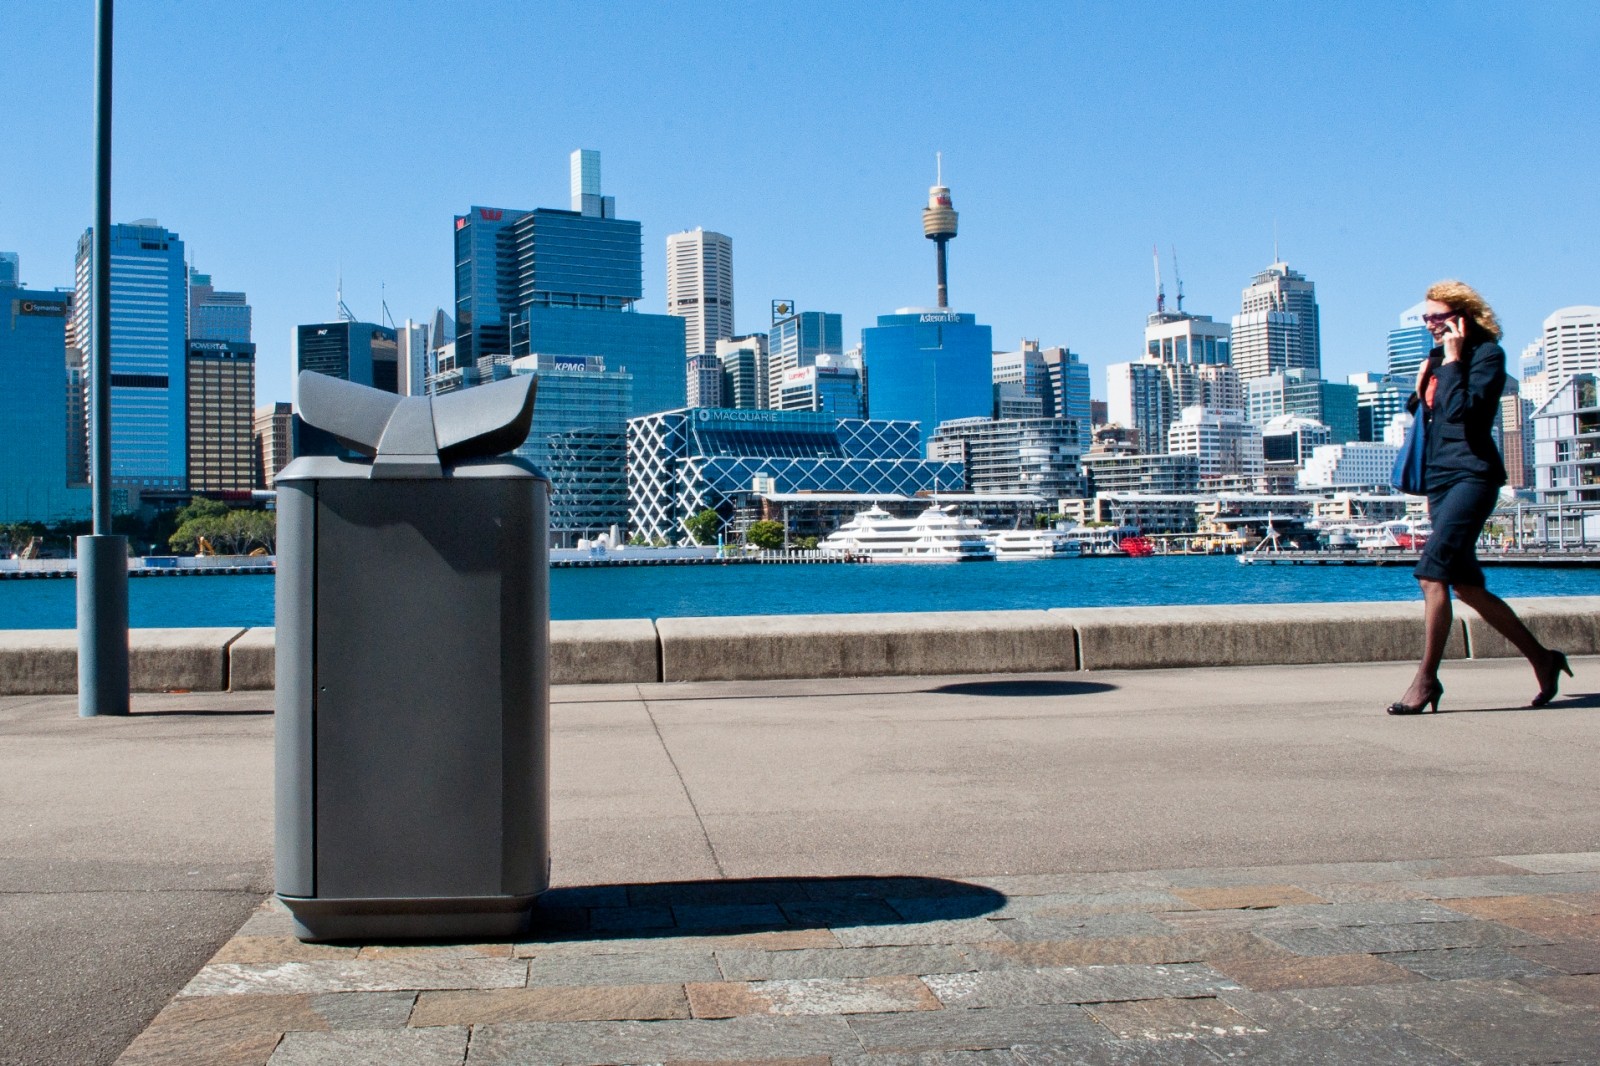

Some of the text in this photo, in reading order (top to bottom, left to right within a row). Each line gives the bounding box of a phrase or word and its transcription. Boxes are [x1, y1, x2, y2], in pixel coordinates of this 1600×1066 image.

[33, 304, 62, 312] Symantec
[920, 313, 960, 323] Asteron Life
[190, 342, 229, 350] POWERTEL
[555, 362, 585, 372] KPMG
[713, 411, 778, 422] MACQUARIE
